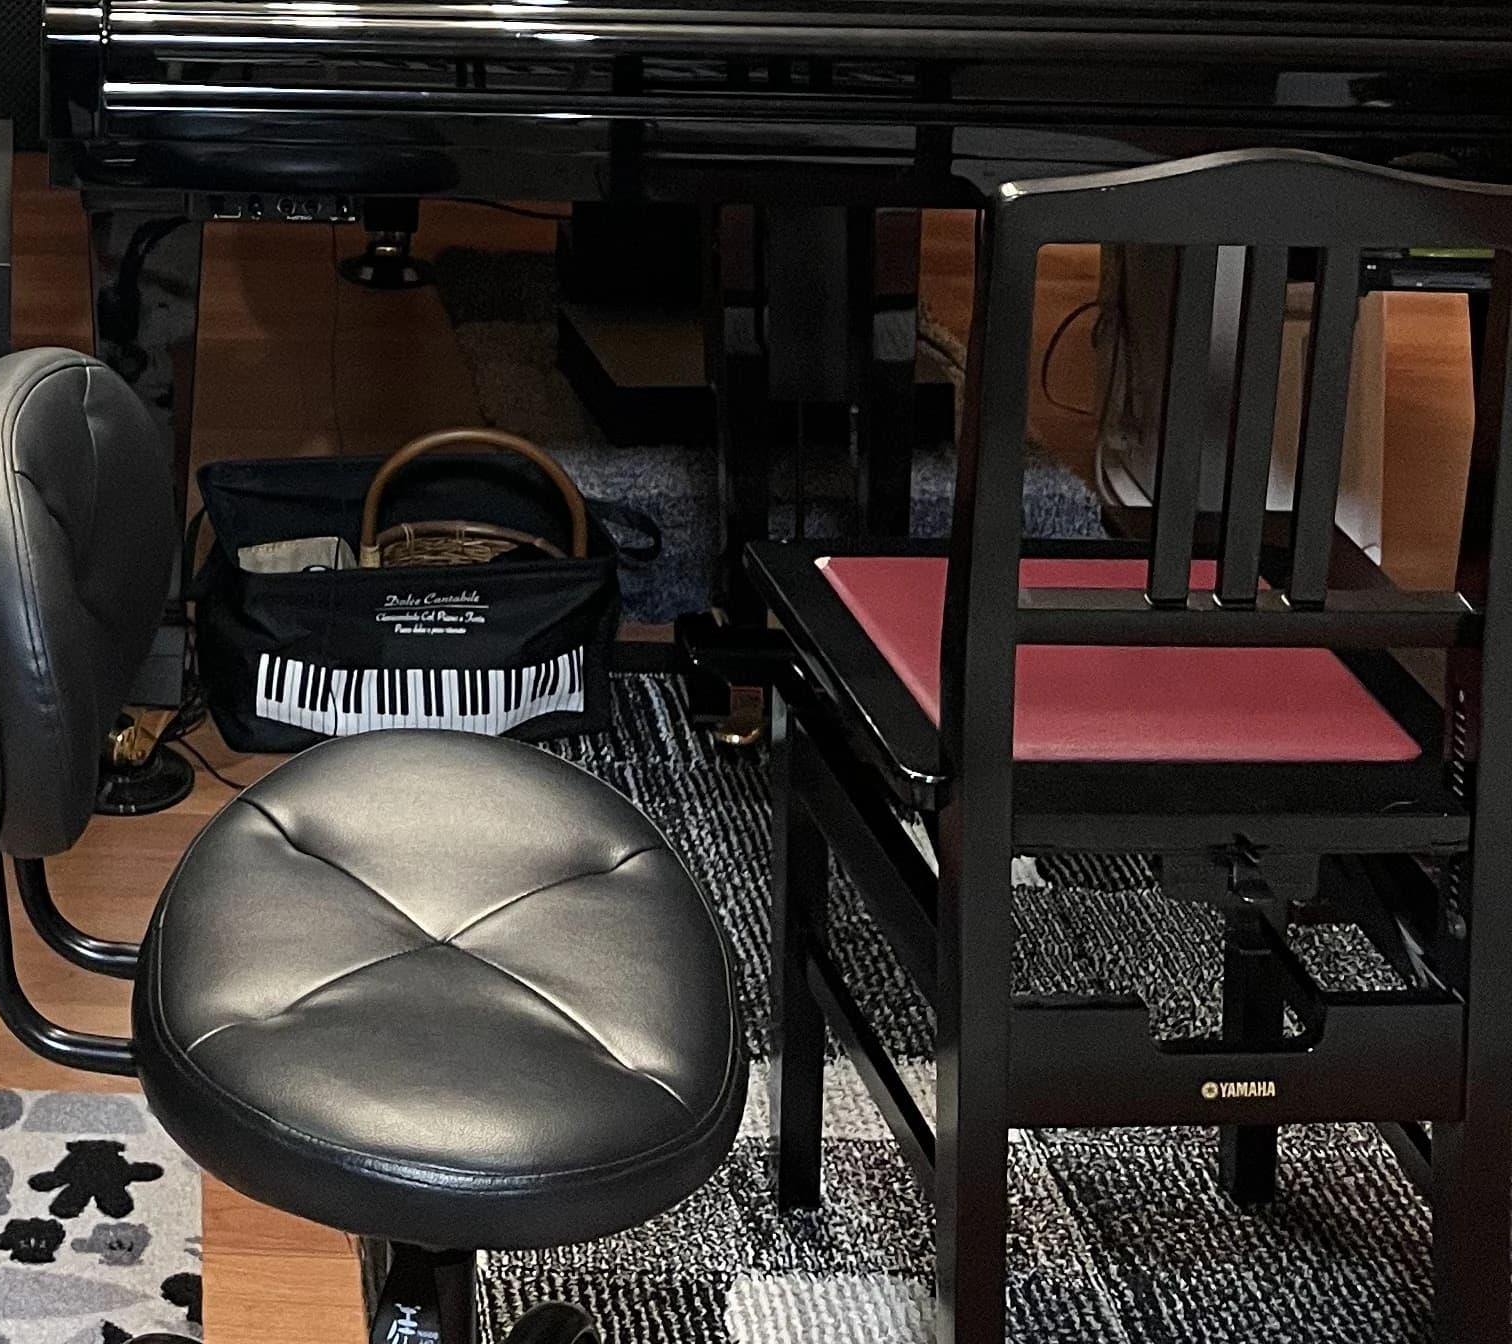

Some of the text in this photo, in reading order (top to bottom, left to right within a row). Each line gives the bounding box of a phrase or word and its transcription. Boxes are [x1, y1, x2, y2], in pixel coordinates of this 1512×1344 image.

[384, 590, 480, 607] Dolce Cantabile
[1219, 1081, 1276, 1098] YAMAHA
